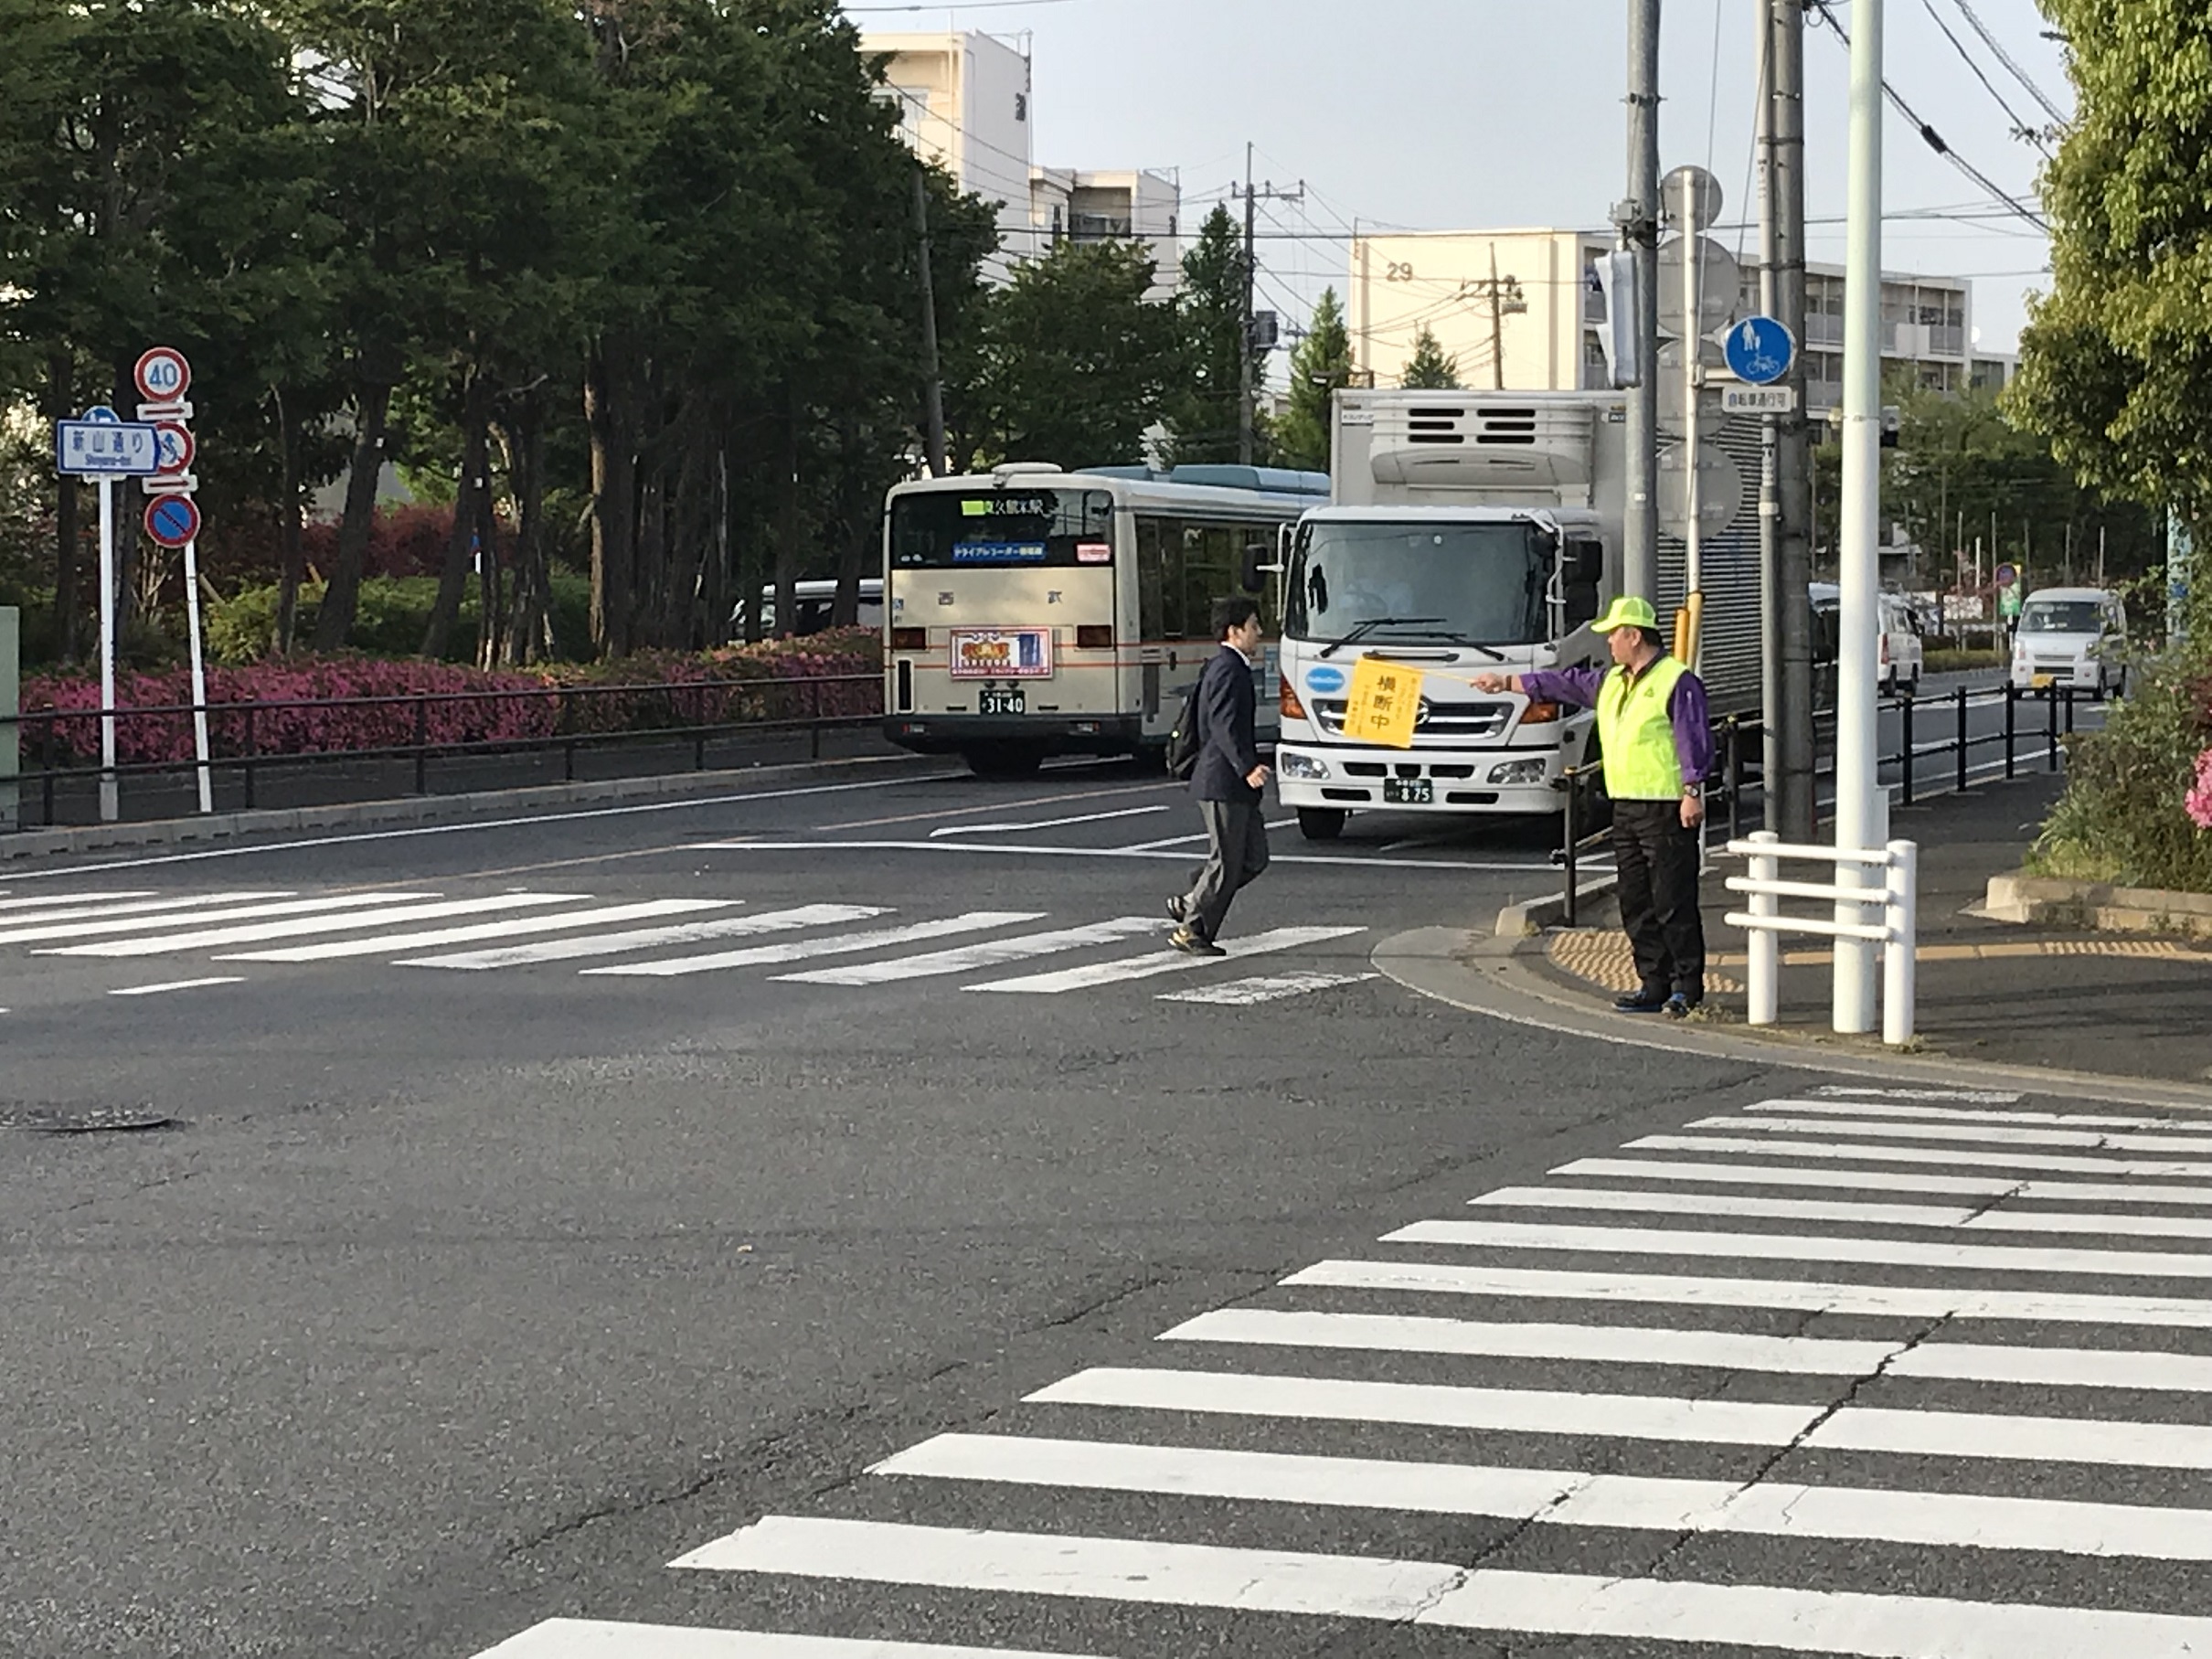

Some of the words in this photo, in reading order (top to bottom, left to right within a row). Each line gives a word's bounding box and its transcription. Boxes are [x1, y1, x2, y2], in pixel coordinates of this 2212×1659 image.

[1387, 262, 1412, 282] 29
[150, 364, 177, 387] 40
[1370, 675, 1397, 729] 横断中
